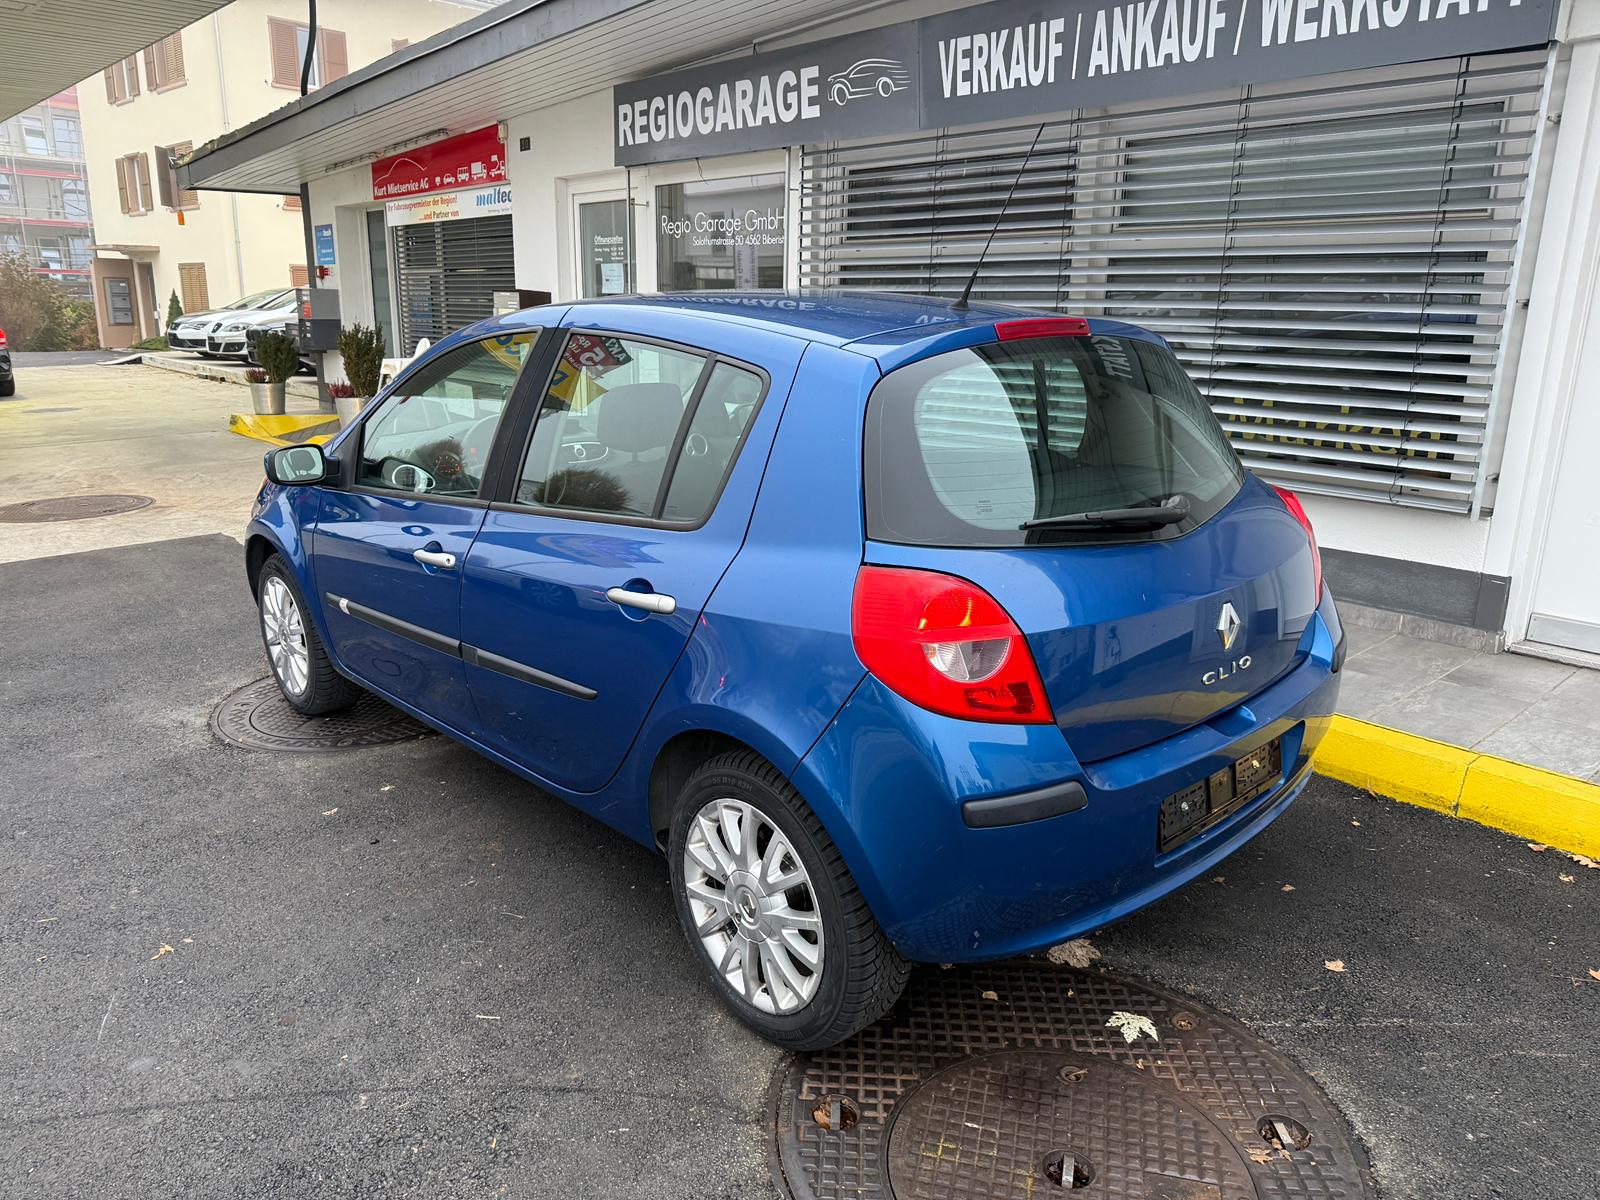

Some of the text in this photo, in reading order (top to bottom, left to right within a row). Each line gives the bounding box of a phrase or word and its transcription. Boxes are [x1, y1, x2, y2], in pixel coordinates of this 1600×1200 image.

[938, 17, 1065, 98] VERKAUF
[1087, 0, 1226, 77] ANKAUF
[618, 65, 821, 147] REGIOGARAGE
[374, 177, 429, 196] Kurt Mietservice AG
[432, 197, 440, 206] der
[433, 210, 449, 219] Partner
[661, 215, 691, 238] Regio
[694, 212, 741, 236] Garage
[735, 235, 744, 246] 50
[745, 234, 761, 245] 4562
[1203, 655, 1252, 685] CLIO
